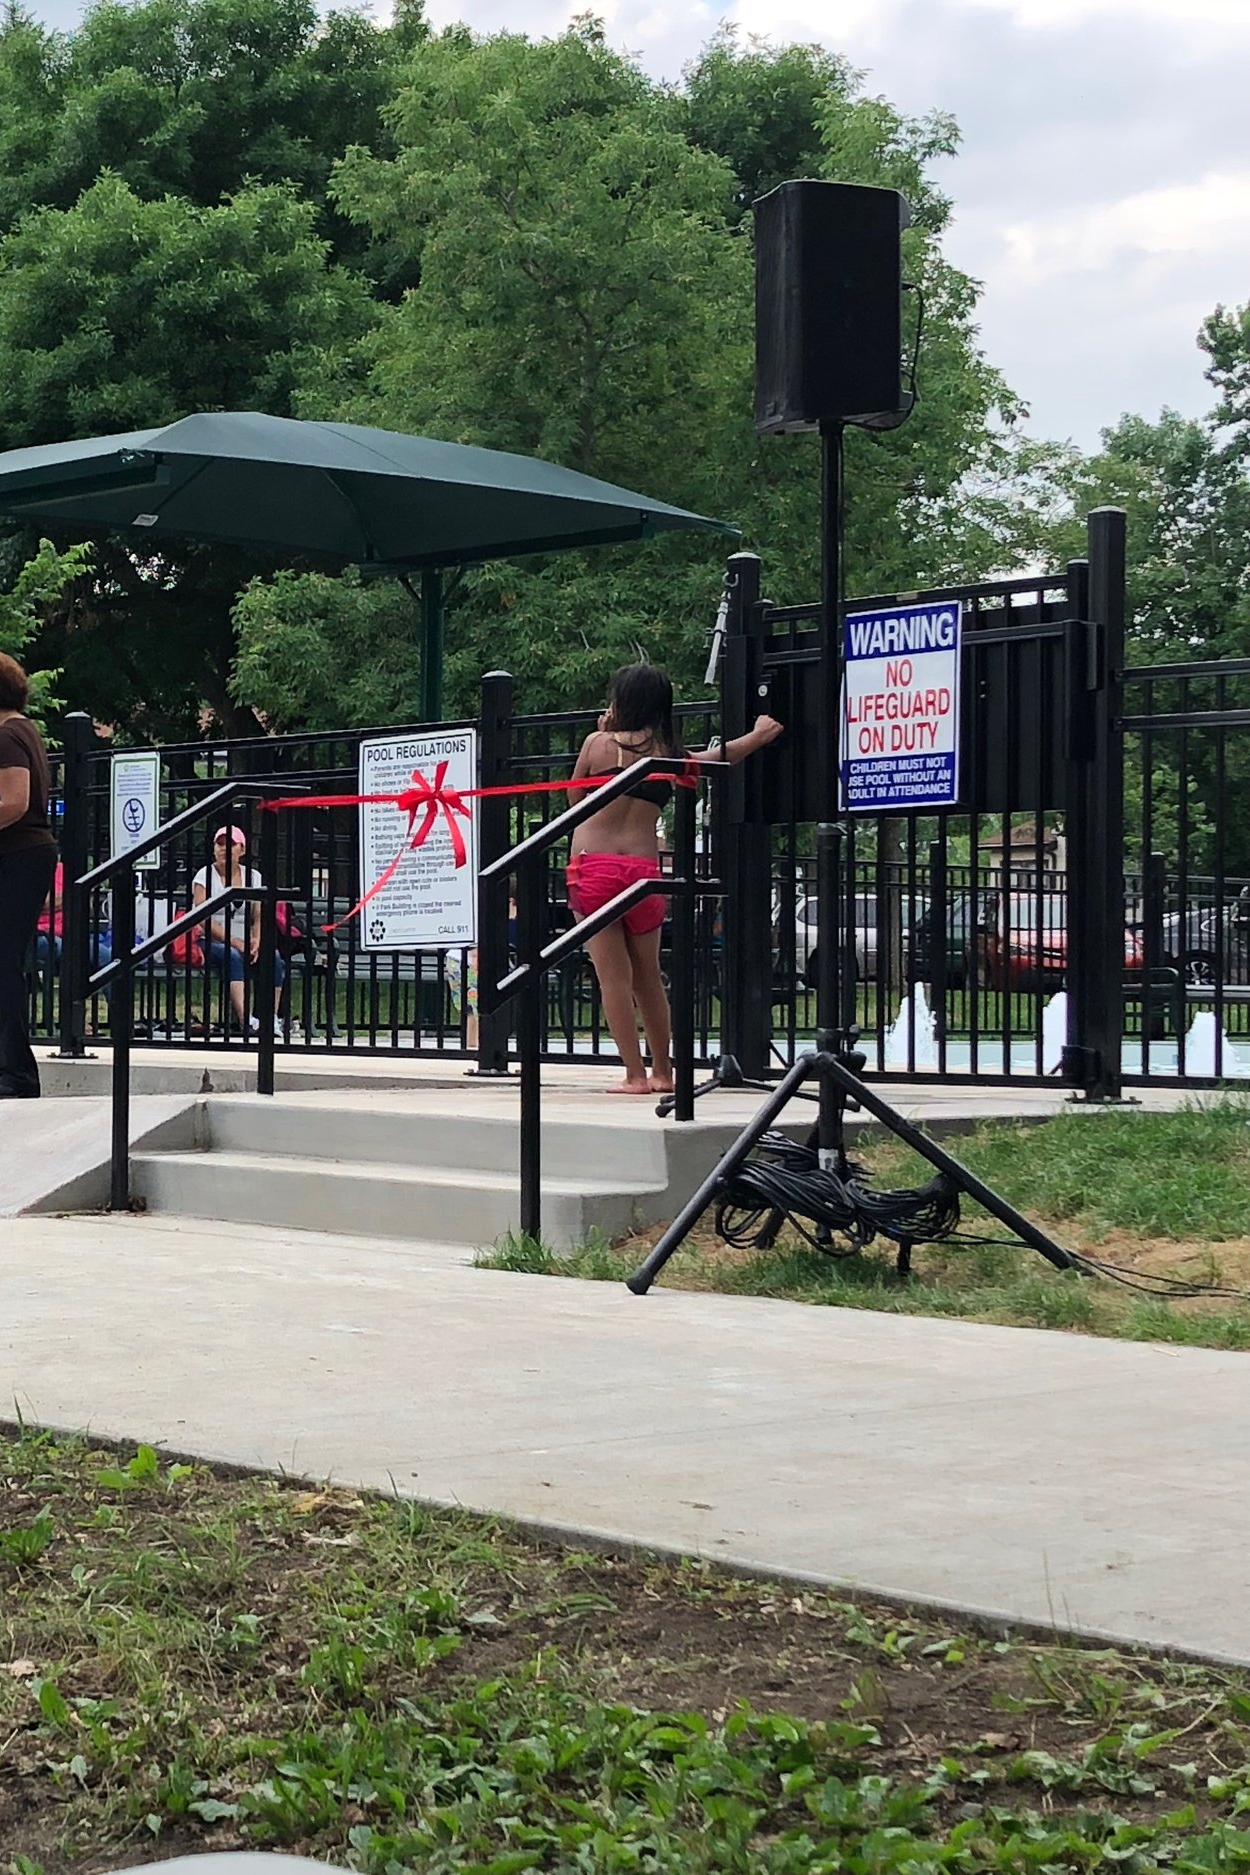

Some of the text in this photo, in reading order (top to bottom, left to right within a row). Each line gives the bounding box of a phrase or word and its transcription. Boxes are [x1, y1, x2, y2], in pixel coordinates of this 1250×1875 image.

[850, 612, 954, 656] WARNING
[886, 659, 913, 688] NO
[848, 688, 950, 723] LIFEGUARD
[859, 721, 938, 754] ON DUTY
[367, 739, 466, 762] POOL REGULATIONS
[850, 756, 947, 774] CHILDREN MUST NOT
[865, 774, 891, 786] POOL
[893, 770, 936, 783] WITHOUT
[937, 769, 952, 780] AN
[877, 786, 887, 798] IN
[888, 782, 950, 797] ATTENDANCE
[438, 925, 469, 934] CALL 911
